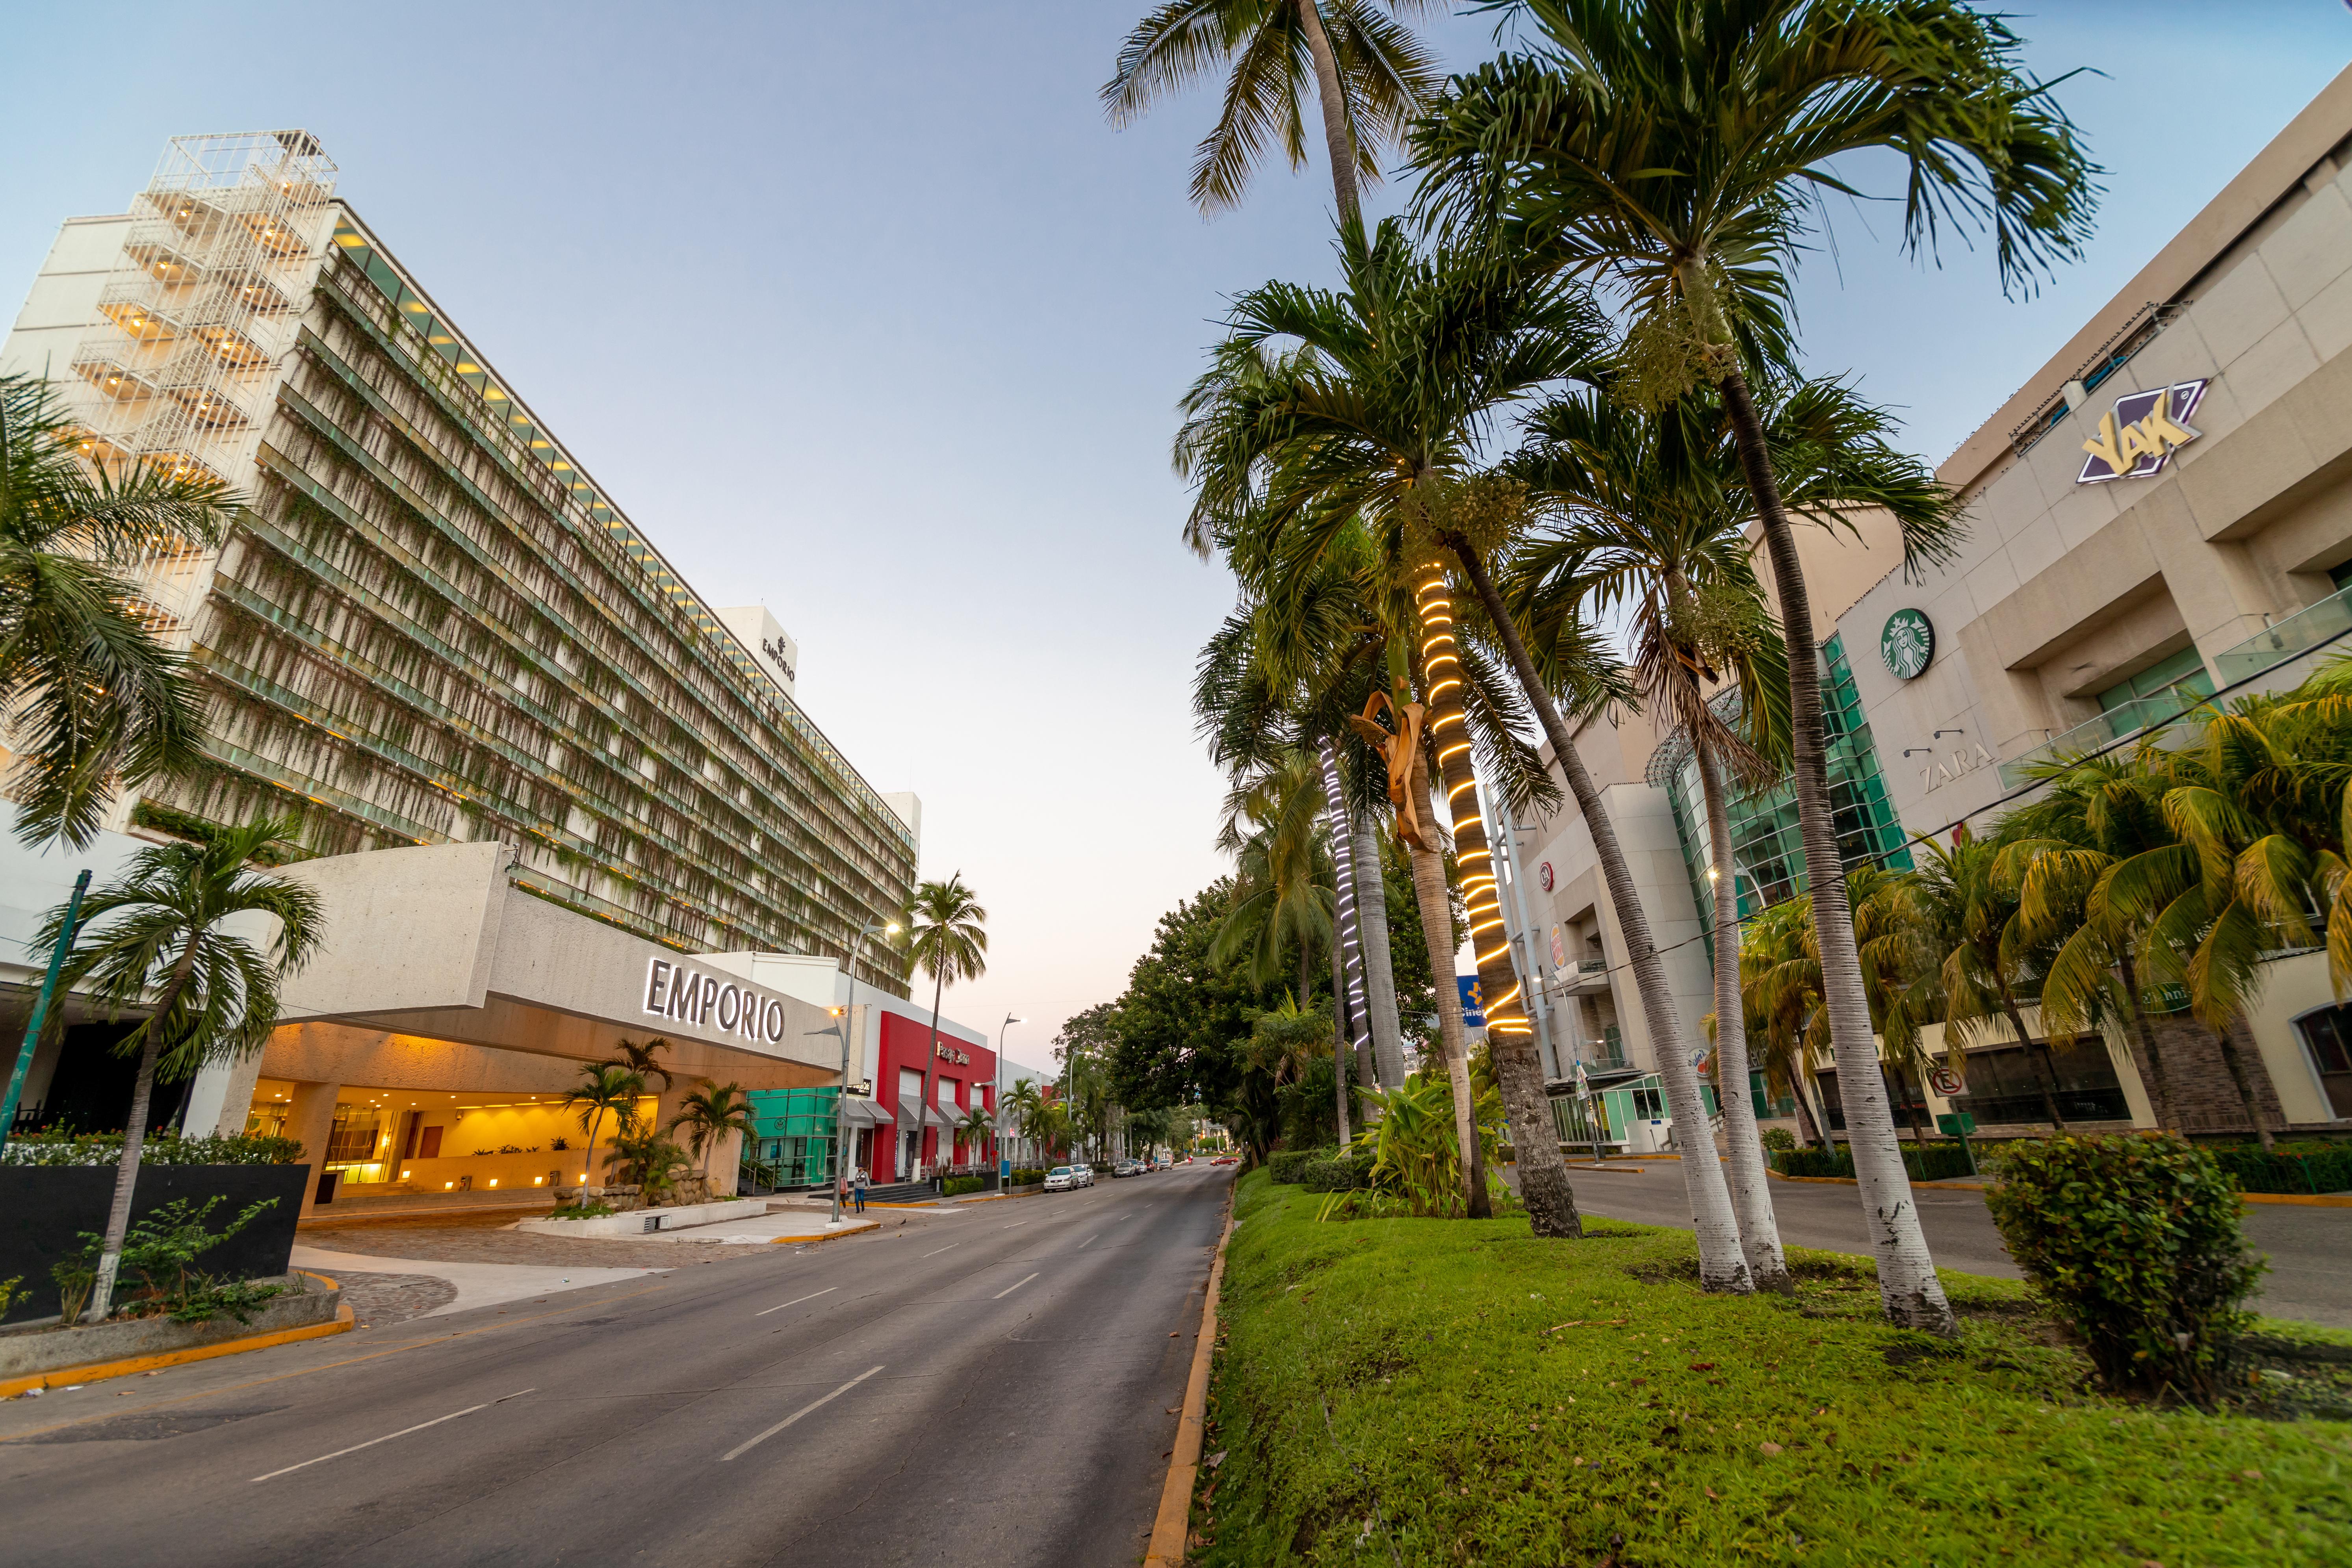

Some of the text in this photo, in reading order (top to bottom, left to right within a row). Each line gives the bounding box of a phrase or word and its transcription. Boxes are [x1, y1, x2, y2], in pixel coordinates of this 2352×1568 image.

[2081, 384, 2197, 477] YAK
[763, 638, 795, 681] EMPORIO
[1919, 740, 1995, 794] ZARA
[645, 959, 785, 1042] EMPORIO
